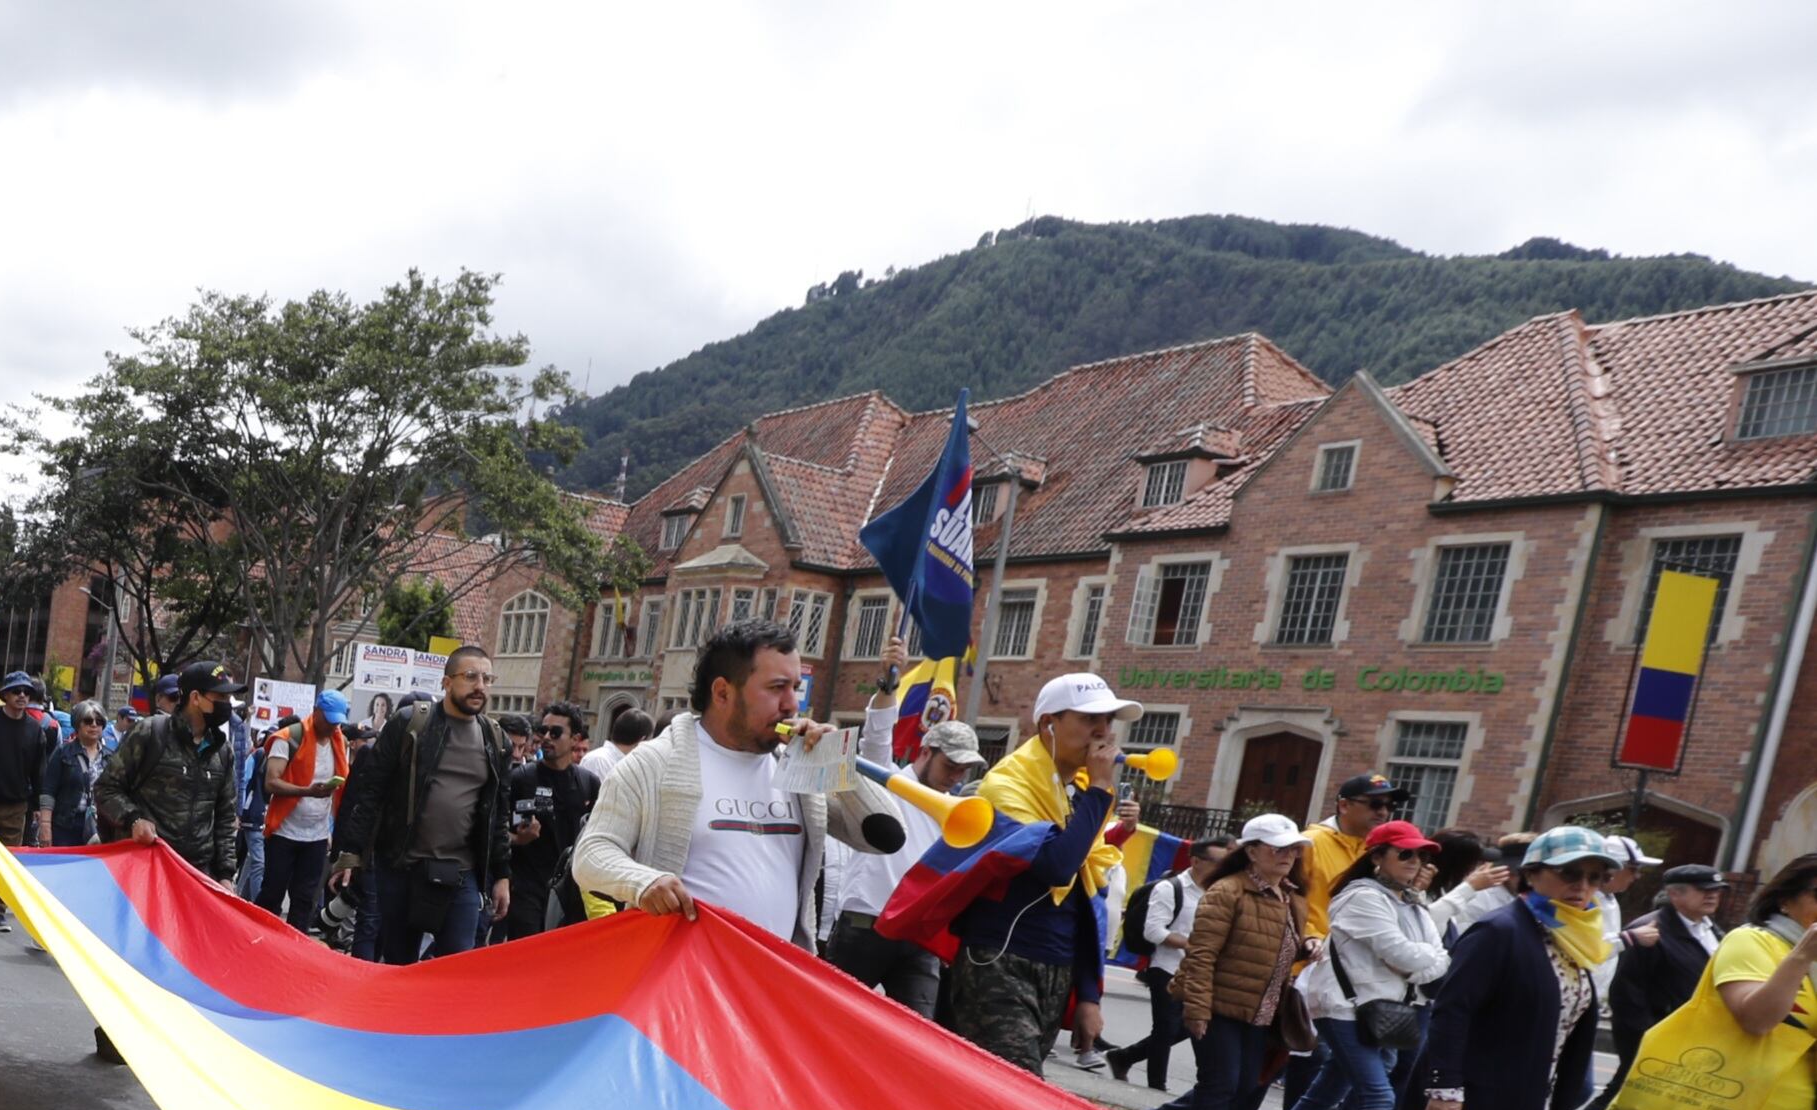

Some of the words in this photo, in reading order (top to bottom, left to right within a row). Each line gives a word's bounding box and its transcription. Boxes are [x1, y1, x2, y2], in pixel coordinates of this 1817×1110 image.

[364, 645, 408, 658] SANDRA
[1118, 666, 1282, 691] Universitaria
[1301, 666, 1336, 691] de
[1356, 665, 1505, 694] Colombia
[714, 798, 795, 820] GUCCI
